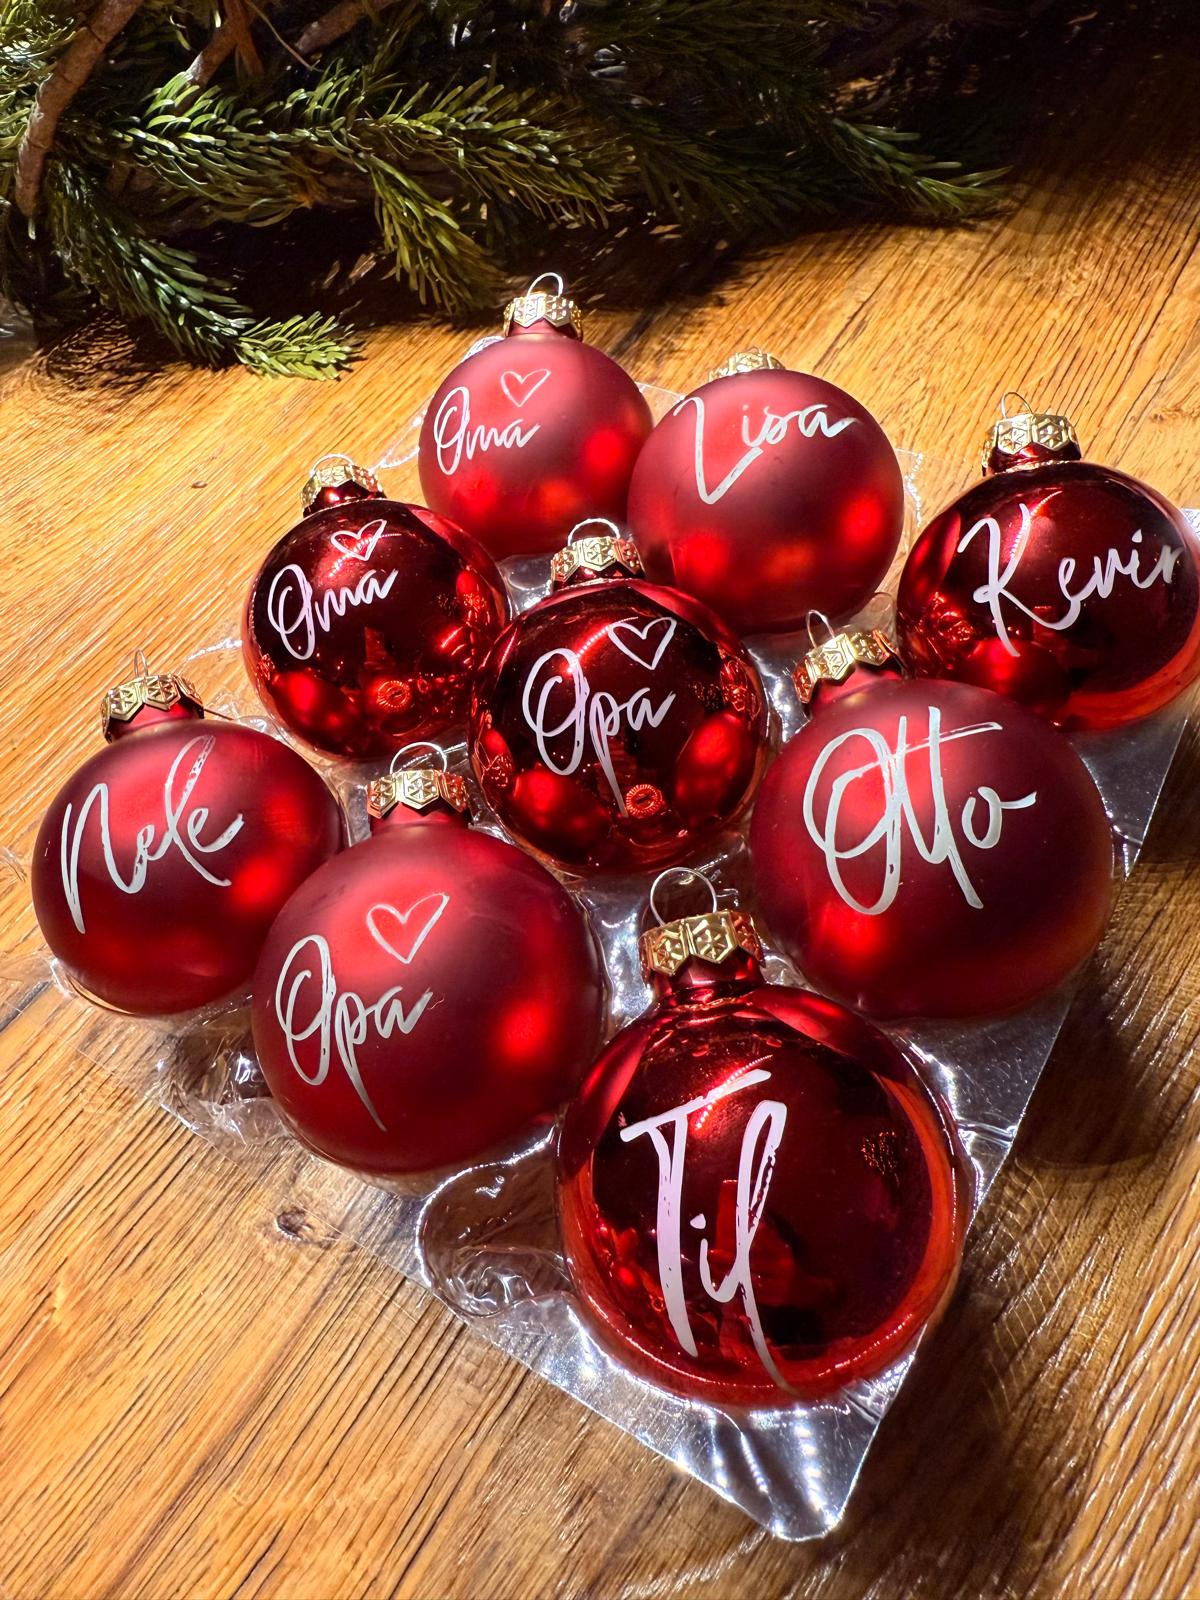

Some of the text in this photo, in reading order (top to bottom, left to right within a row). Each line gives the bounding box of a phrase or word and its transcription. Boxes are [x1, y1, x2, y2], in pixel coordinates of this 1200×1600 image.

[433, 386, 541, 476] Oma
[673, 397, 860, 505] Lisa
[267, 564, 399, 660] Oma
[522, 648, 676, 817] Opa
[803, 706, 1037, 916] Otto
[60, 735, 245, 934] Nele
[275, 935, 433, 1132] Opa
[620, 1069, 798, 1394] Til
